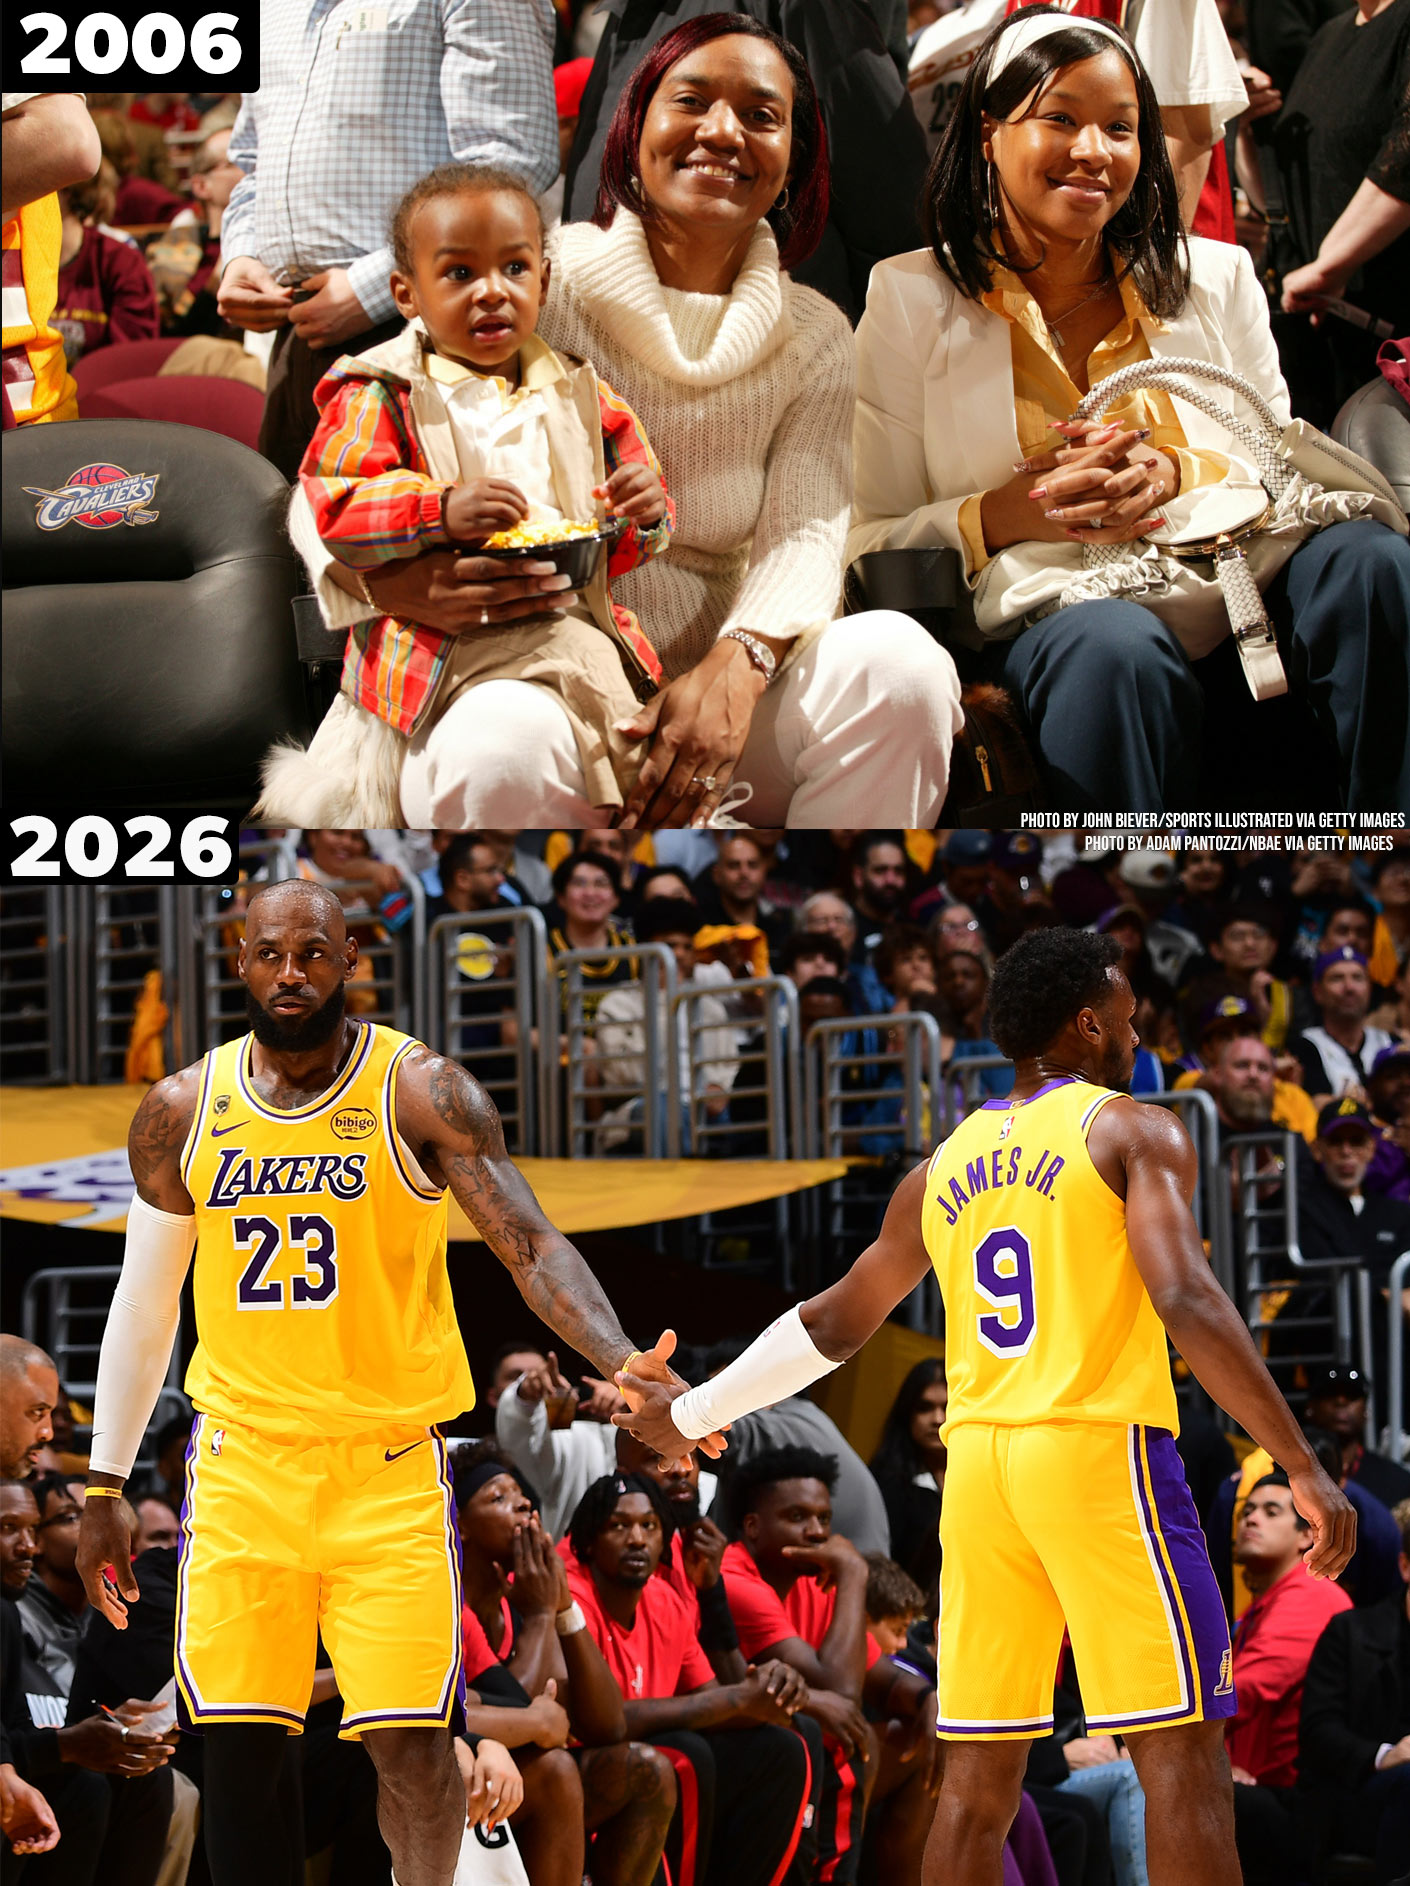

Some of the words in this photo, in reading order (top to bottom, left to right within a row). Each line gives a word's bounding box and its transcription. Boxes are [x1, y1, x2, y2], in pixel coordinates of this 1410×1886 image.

[40, 480, 153, 527] CAVALIERS
[94, 477, 140, 493] CLEVELAND
[335, 1116, 374, 1131] bibigo
[205, 1147, 369, 1209] LAKERS
[936, 1146, 1022, 1226] JAMES
[1025, 1150, 1065, 1202] JR.
[232, 1213, 339, 1311] 23
[972, 1224, 1038, 1360] 9
